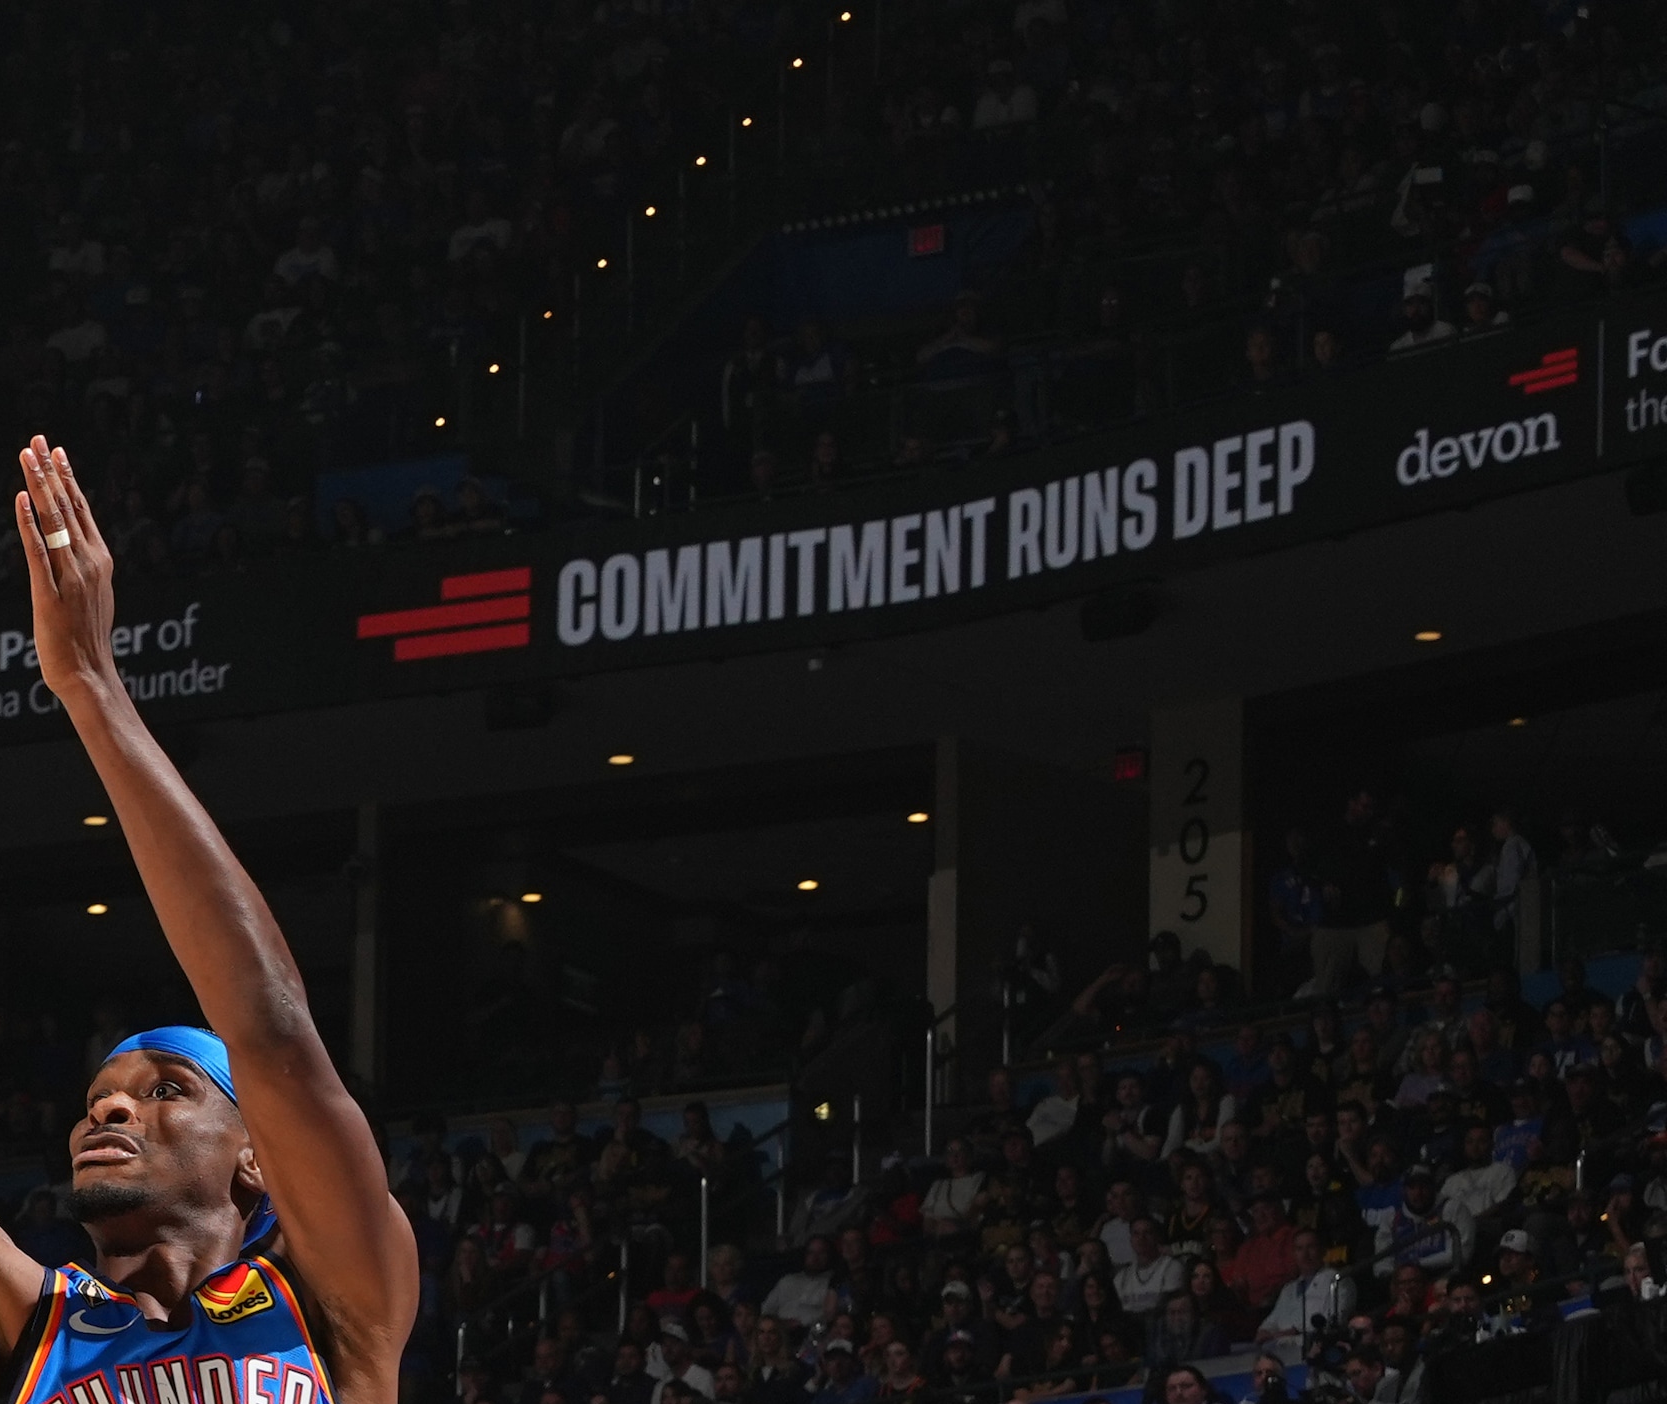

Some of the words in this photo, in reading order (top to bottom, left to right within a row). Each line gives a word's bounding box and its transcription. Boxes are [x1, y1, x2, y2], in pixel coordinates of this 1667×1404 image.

[1395, 411, 1561, 487] devon
[557, 498, 995, 647] COMMITMENT
[1008, 457, 1158, 580] RUNS
[1172, 419, 1316, 540] DEEP
[157, 603, 201, 650] of
[122, 659, 232, 701] hunder
[1179, 757, 1211, 922] 205
